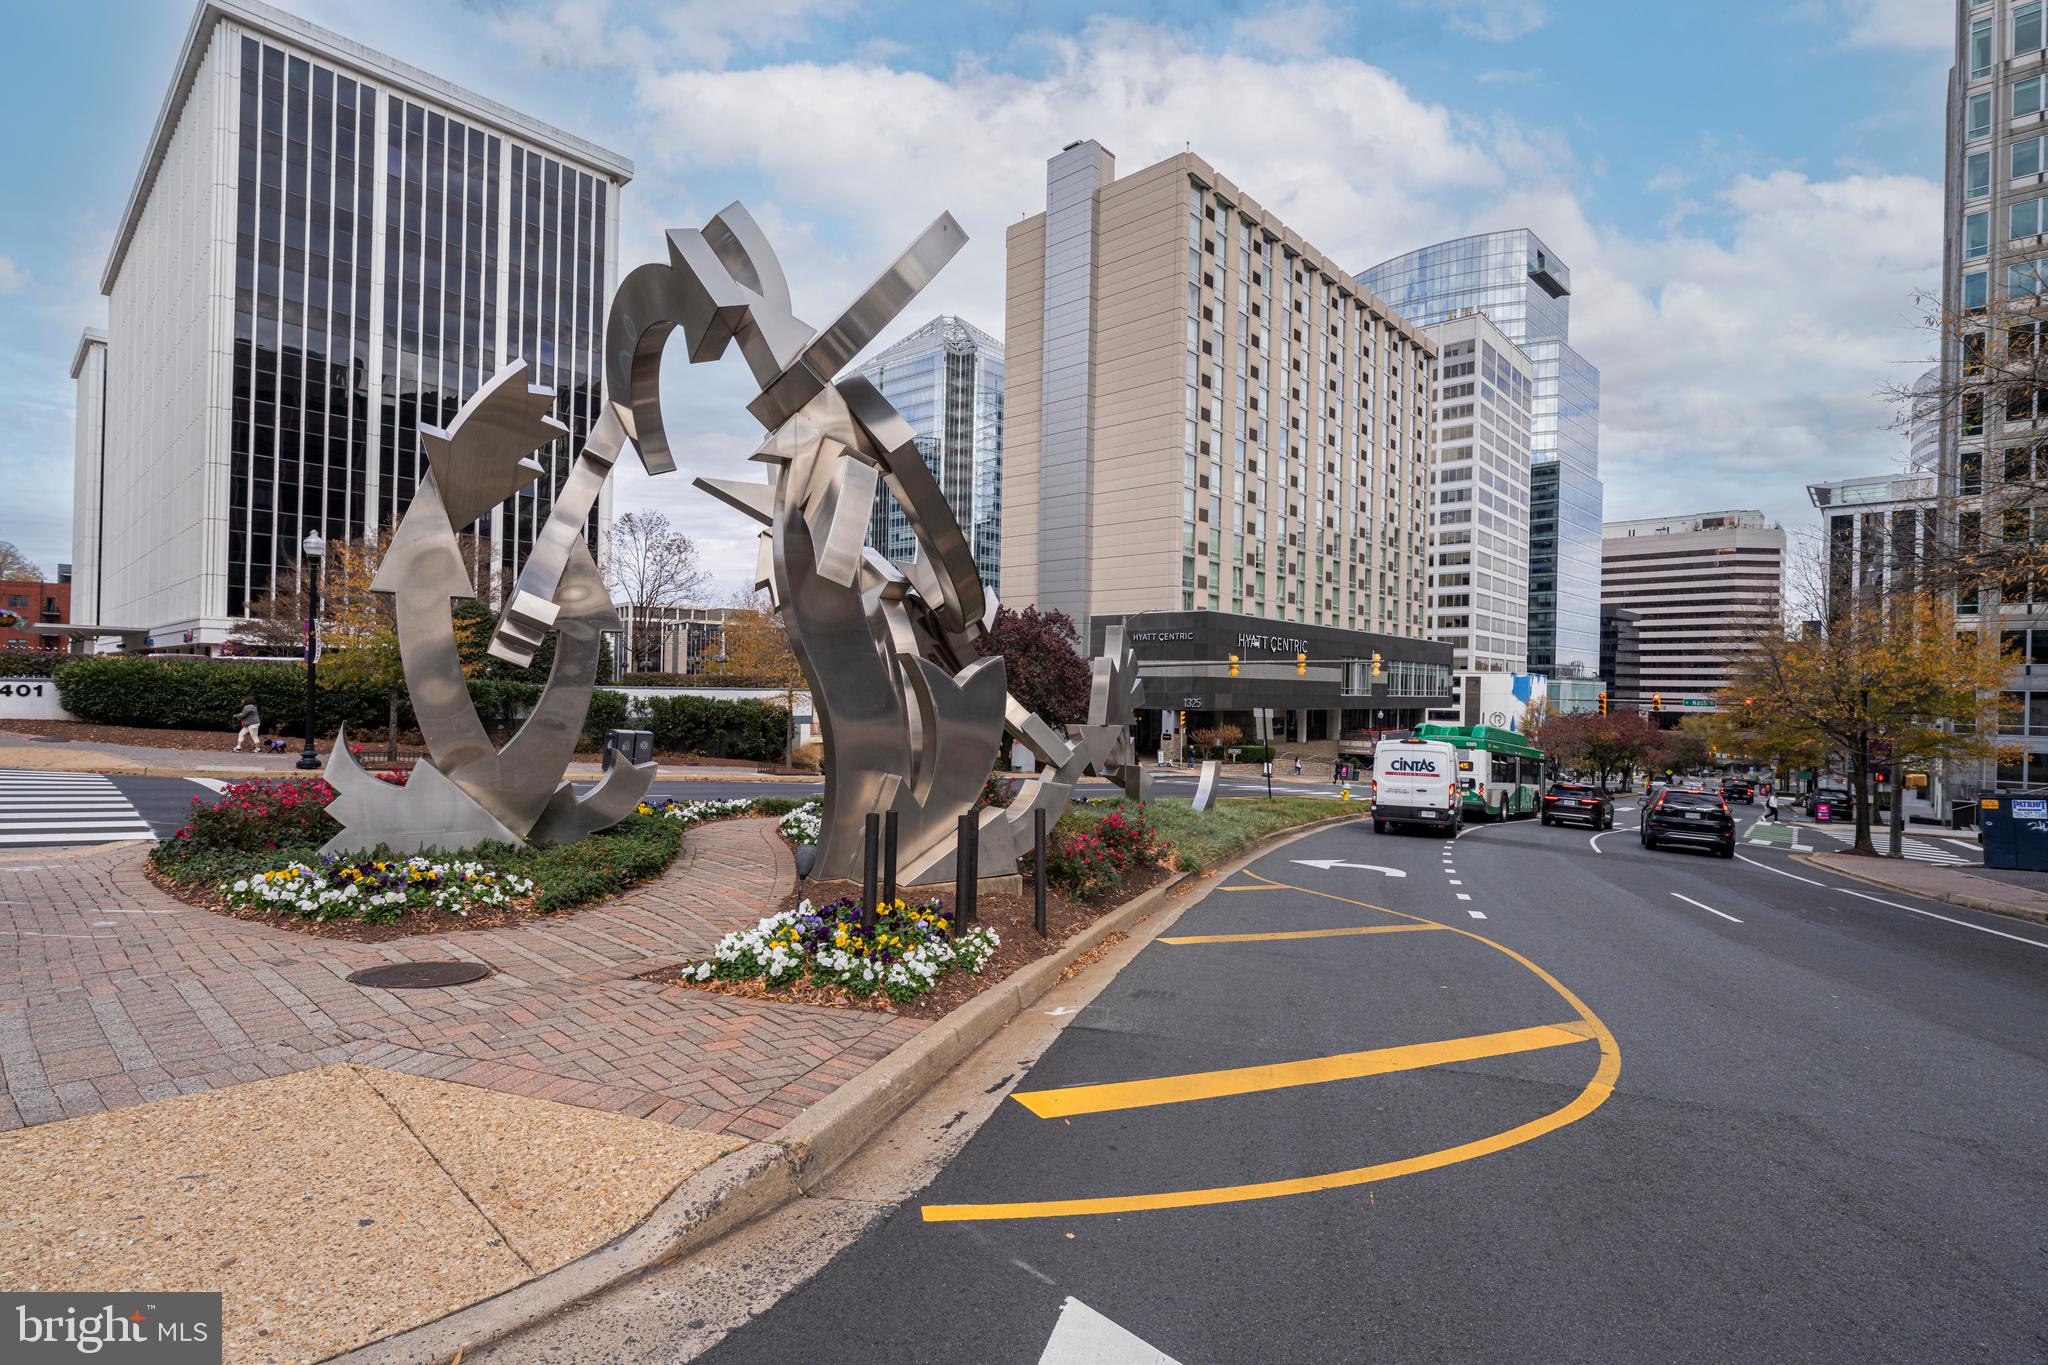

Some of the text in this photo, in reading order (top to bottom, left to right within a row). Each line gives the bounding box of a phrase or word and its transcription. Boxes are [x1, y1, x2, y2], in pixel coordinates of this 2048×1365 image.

[1133, 632, 1194, 642] HYATT CENTRIC
[1238, 633, 1308, 653] HYATT CENTRIC
[0, 684, 43, 697] 401
[1184, 698, 1202, 708] 1325
[2013, 801, 2047, 810] PATRIOT
